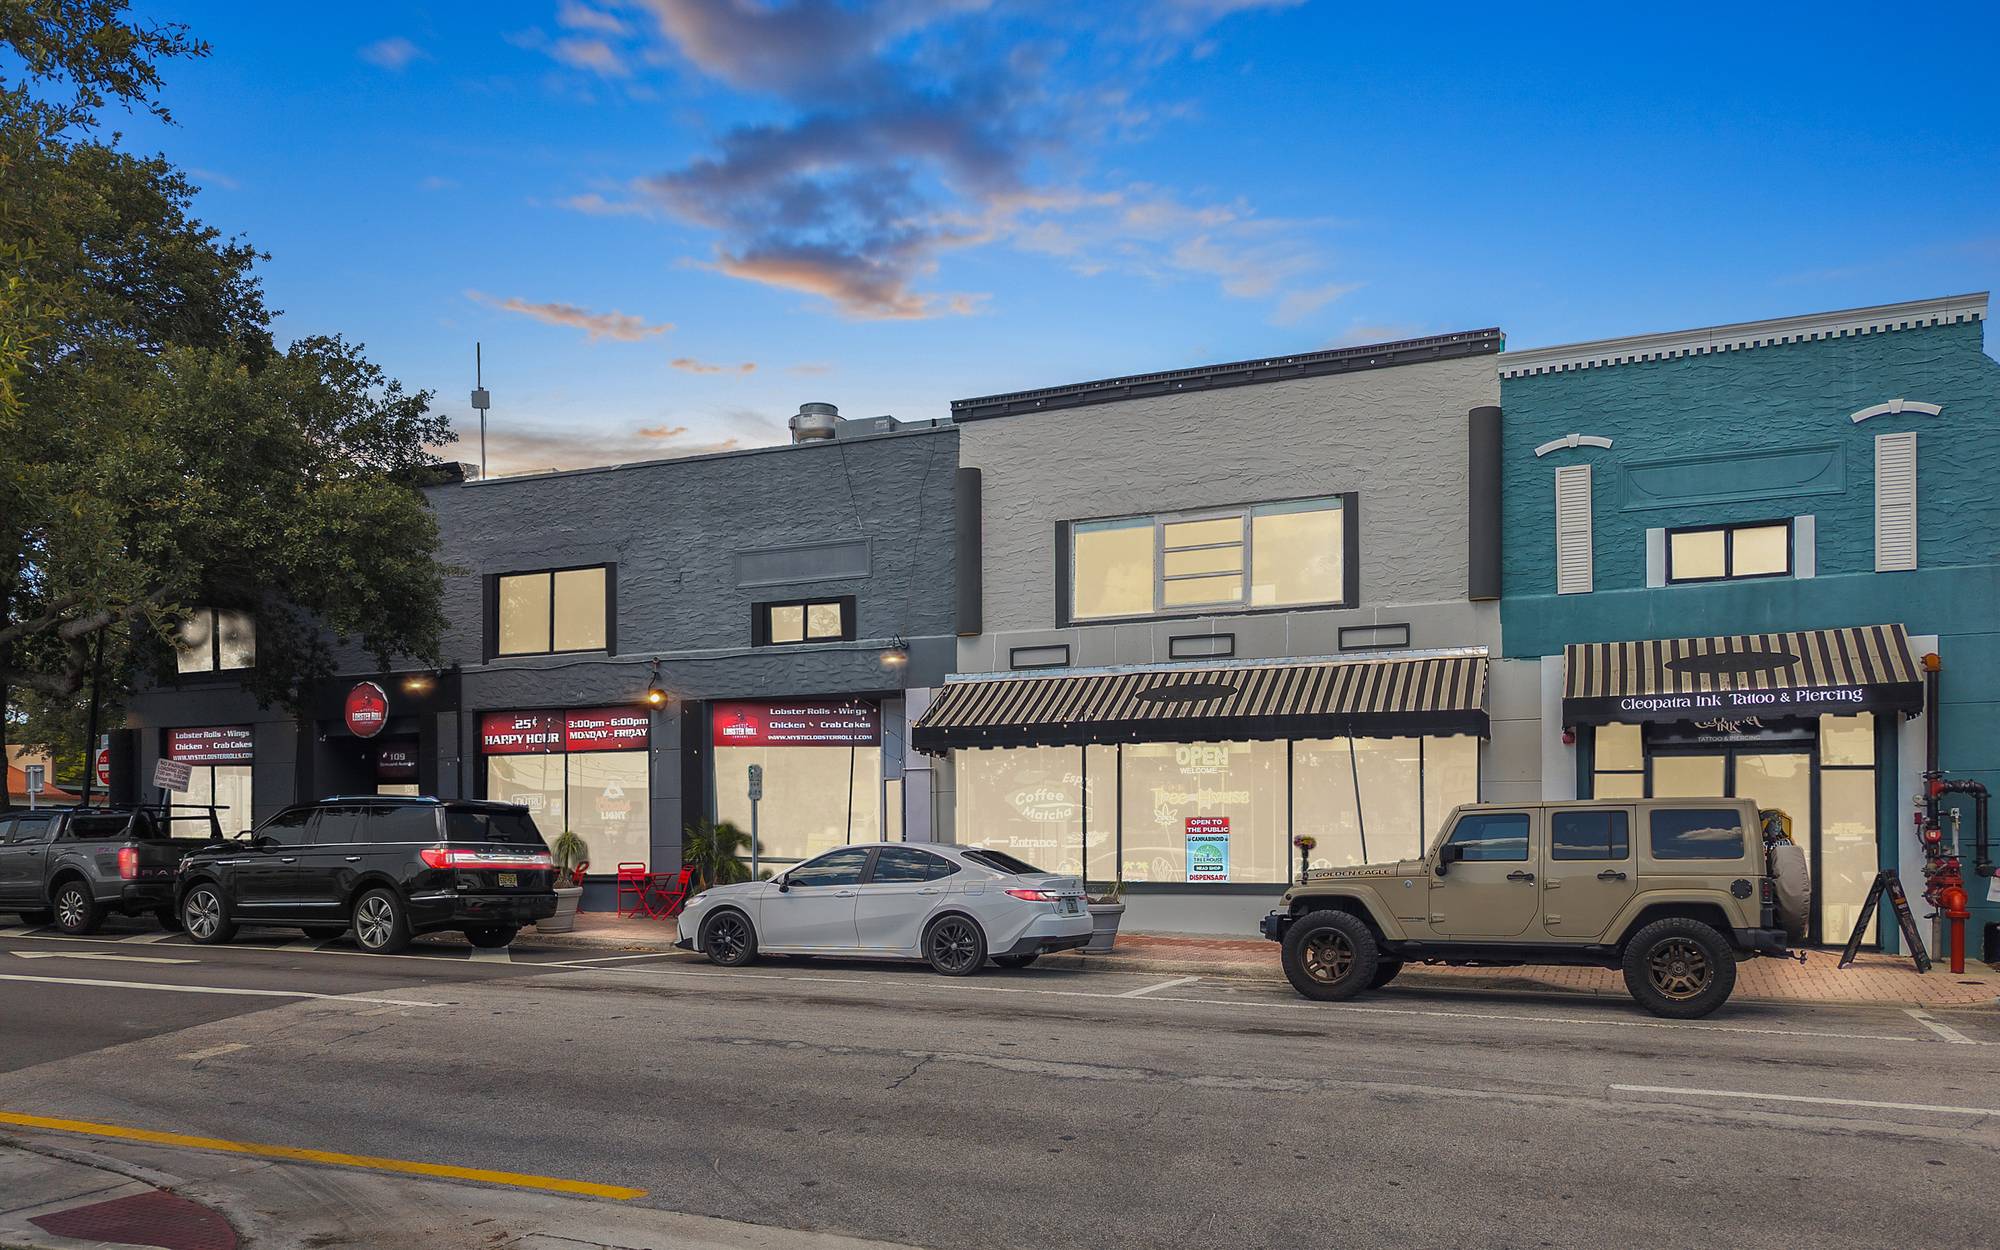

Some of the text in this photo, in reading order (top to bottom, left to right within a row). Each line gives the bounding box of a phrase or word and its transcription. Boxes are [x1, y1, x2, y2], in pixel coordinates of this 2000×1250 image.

[1620, 688, 1863, 711] Cleopatra Ink Tattoo & Piercing
[838, 708, 867, 716] Wings
[568, 719, 605, 729] 3:00pm
[610, 717, 649, 727] 6:00pm
[769, 721, 871, 729] Chicken Crab Cakes
[175, 730, 250, 740] Lobster Rolls Wings
[484, 732, 560, 745] HAPPY HOUR
[569, 729, 608, 741] MONDAY
[613, 728, 648, 738] FRIDAY
[175, 741, 253, 751] Chicken Crab Cakes
[390, 752, 406, 761] 109
[1176, 745, 1229, 766] OPEN
[1180, 767, 1218, 775] WELCOME
[1015, 788, 1065, 806] Coffee
[1022, 806, 1072, 821] Matcha
[1008, 835, 1058, 848] Entrance
